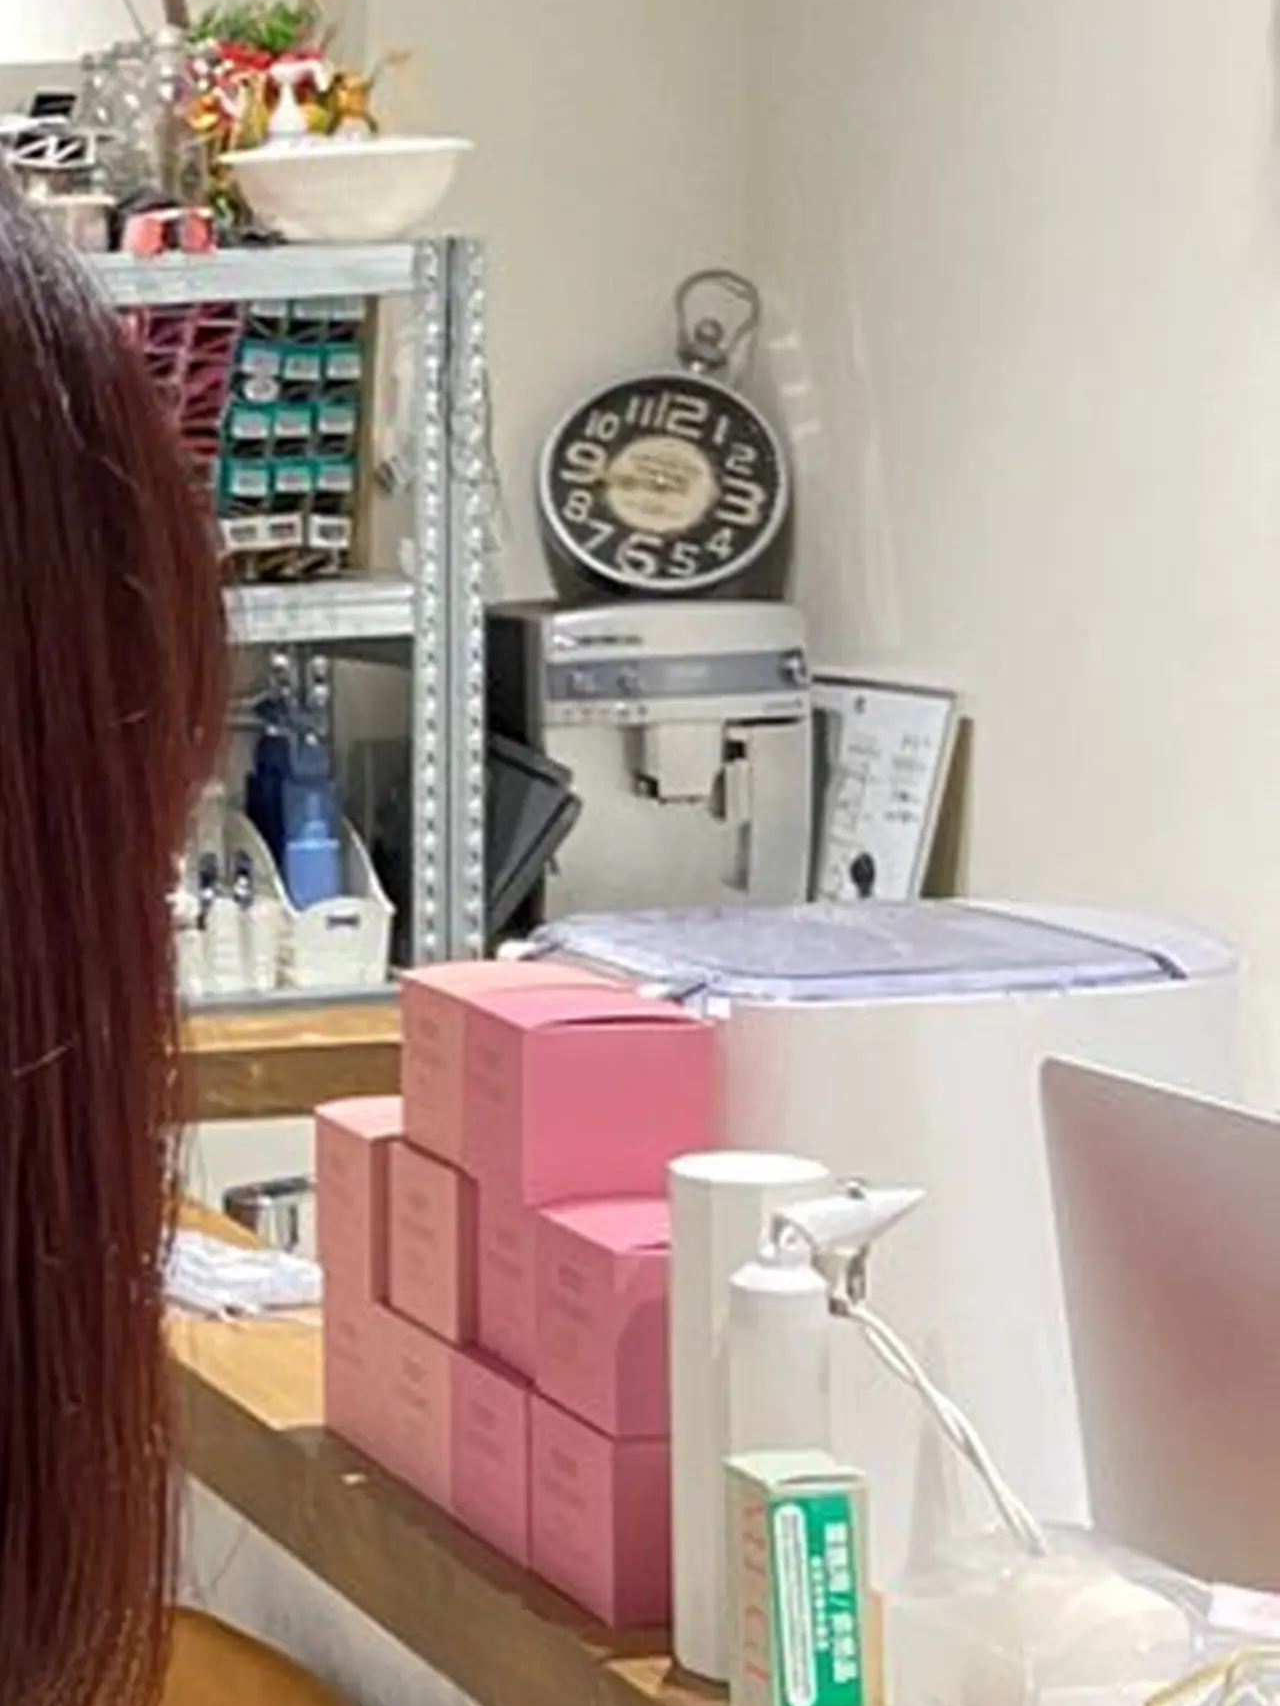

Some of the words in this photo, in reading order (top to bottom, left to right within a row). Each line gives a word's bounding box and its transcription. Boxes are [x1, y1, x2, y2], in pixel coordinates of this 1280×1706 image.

[584, 410, 620, 440] 10
[625, 396, 655, 427] 11
[653, 393, 709, 439] 12
[712, 415, 729, 444] 1
[558, 443, 608, 484] 9
[725, 445, 757, 475] 2
[562, 491, 590, 523] 8
[715, 477, 767, 525] 3
[582, 519, 615, 551] 7
[706, 528, 734, 559] 4
[615, 532, 664, 578] 6
[668, 543, 701, 576] 5
